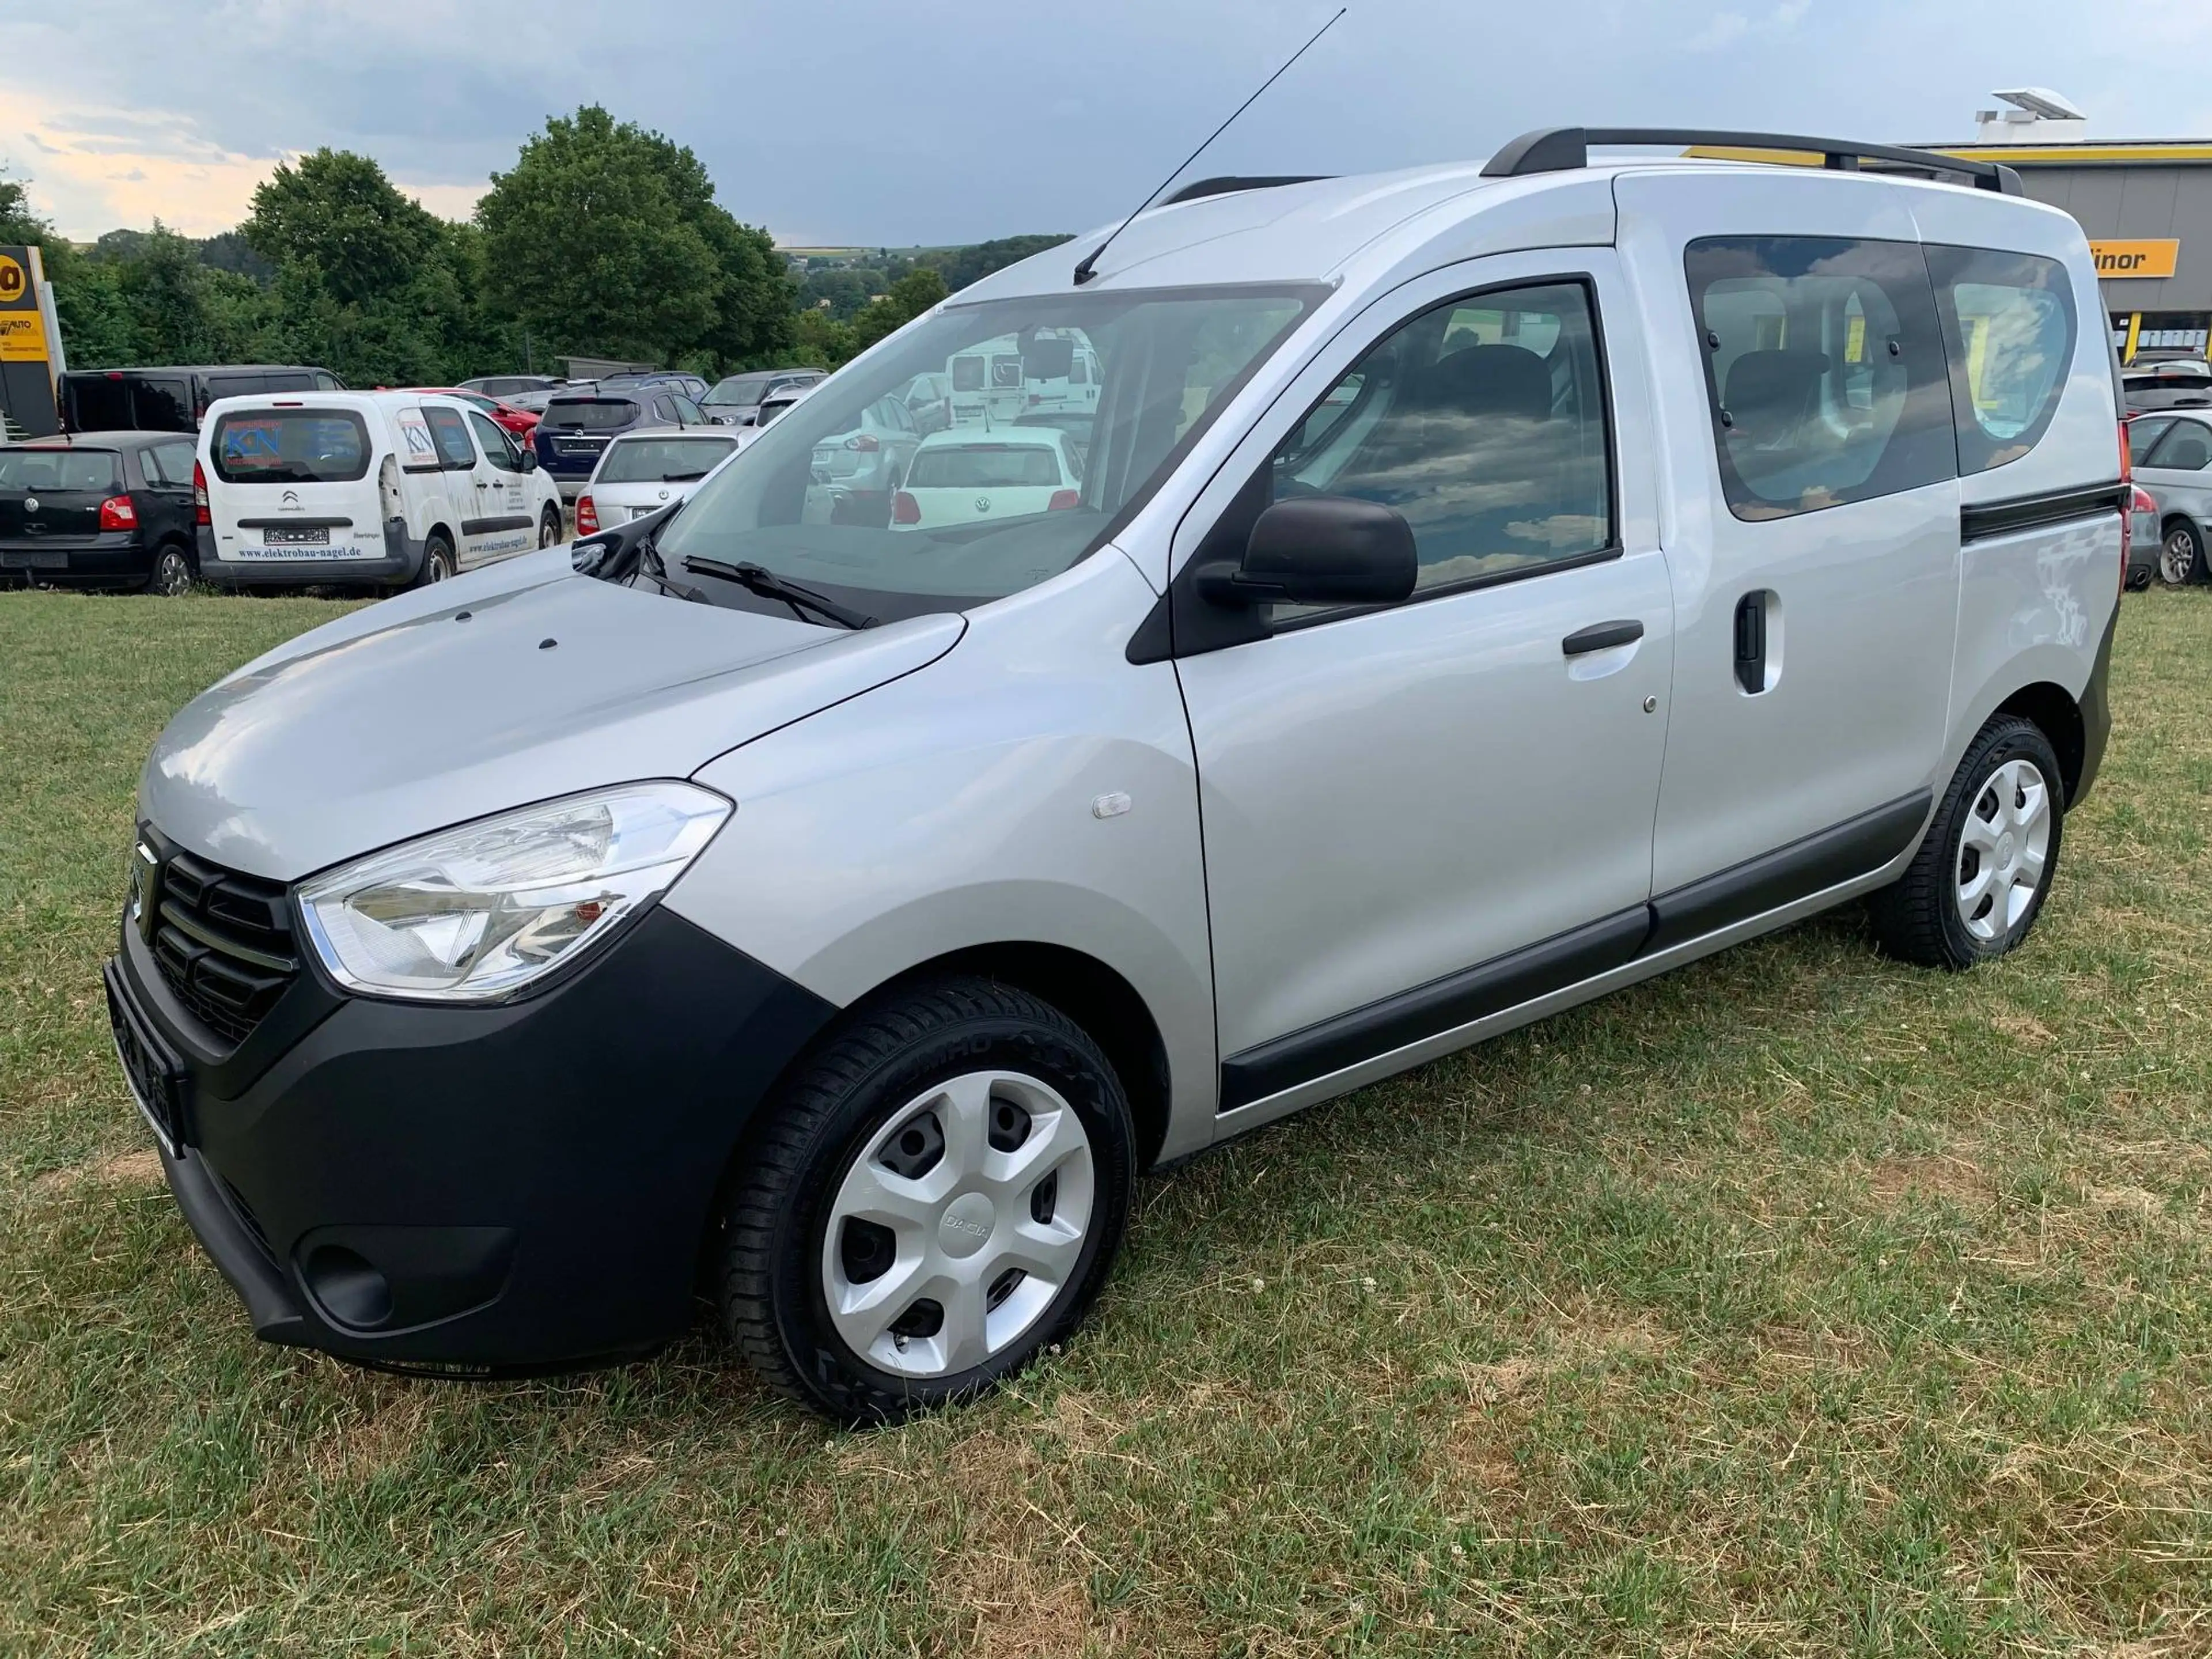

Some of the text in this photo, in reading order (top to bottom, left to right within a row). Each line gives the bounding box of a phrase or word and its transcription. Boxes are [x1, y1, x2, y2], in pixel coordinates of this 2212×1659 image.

[2091, 248, 2146, 269] inor
[238, 547, 361, 558] www.elektrobau-nagel.de
[945, 1215, 987, 1239] DACIA
